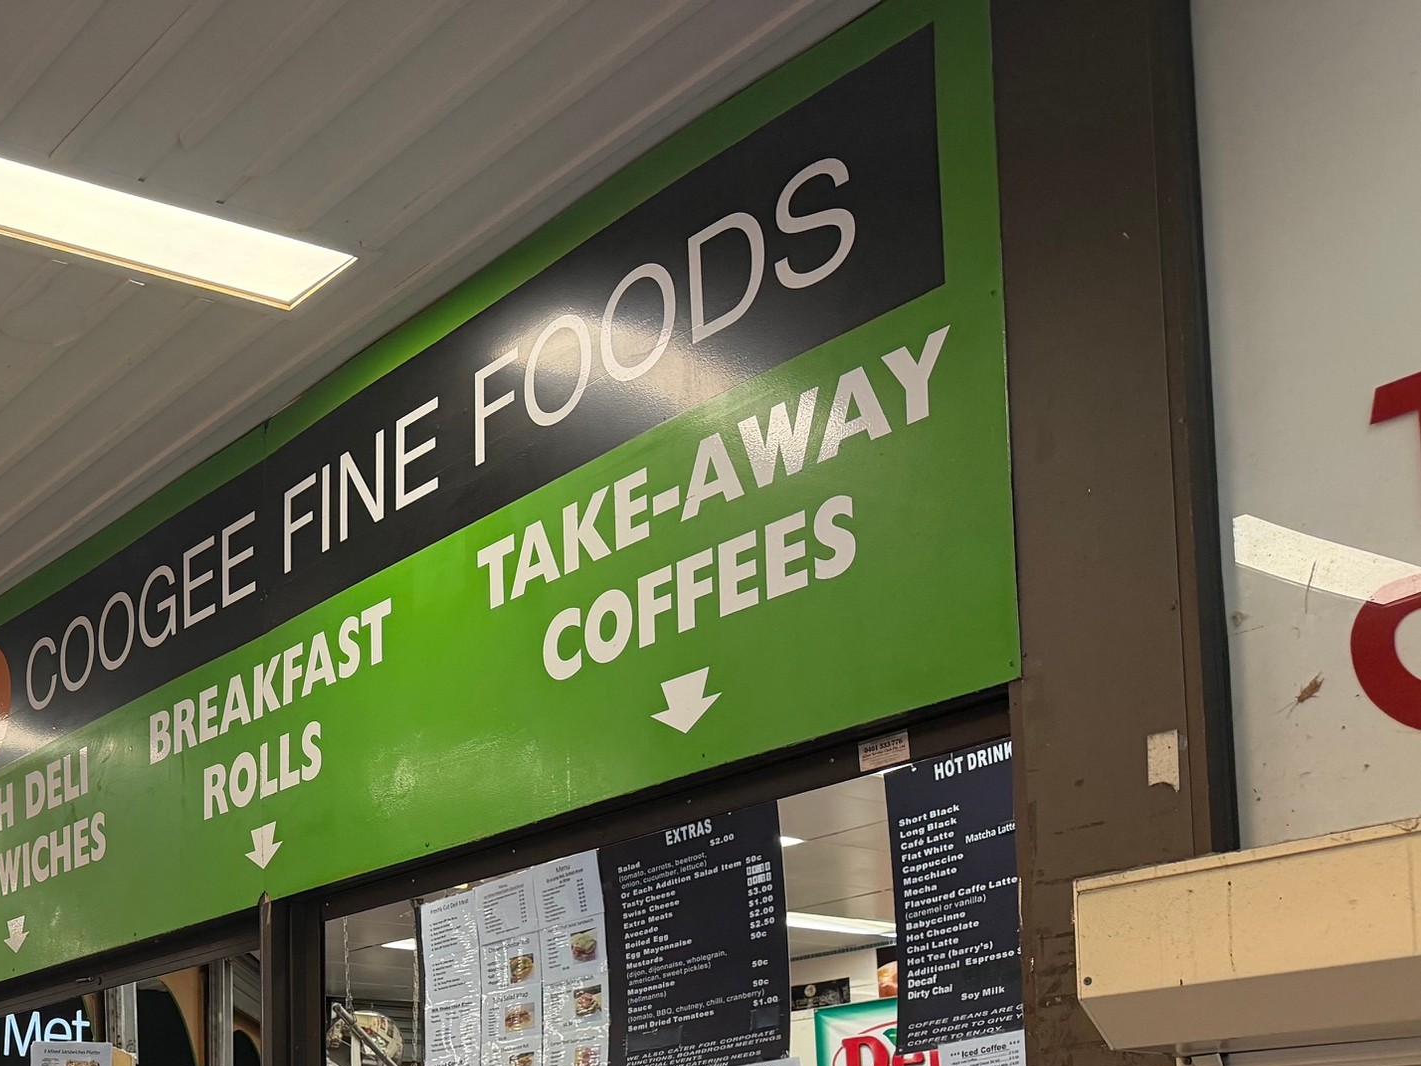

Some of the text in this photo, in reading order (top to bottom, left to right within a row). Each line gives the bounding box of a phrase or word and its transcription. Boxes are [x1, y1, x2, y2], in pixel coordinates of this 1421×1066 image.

[24, 155, 858, 712] COOGEE FINE FOODS
[475, 323, 953, 610] TAKE-AWAY
[540, 493, 859, 682] COFFEES
[147, 598, 395, 766] BREAKFAST
[202, 720, 325, 821] ROLLS
[934, 756, 963, 781] HOT
[967, 741, 1013, 771] DRINK
[23, 745, 91, 818] DELI
[898, 804, 960, 827] Short Black
[665, 818, 712, 846] EXTRAS
[900, 817, 957, 839] Long Black
[965, 822, 1015, 845] Matcha Latte
[901, 830, 955, 851] Café Latte
[901, 842, 954, 863] Flat White
[618, 833, 735, 873] Salad $2.00
[902, 852, 964, 876] Cappuccino
[633, 885, 653, 896] Each
[656, 875, 691, 890] Addition
[694, 867, 719, 879] Salad
[721, 860, 742, 872] Item
[745, 854, 762, 864] 50c
[903, 866, 957, 886] Macchiato
[622, 890, 676, 910] Tasty Cheese
[904, 884, 938, 898] Mocha
[904, 876, 1018, 910] Flavoured Caffe Latte
[623, 884, 773, 930] Extra Meats $3.00
[623, 899, 680, 920] Swiss Cheese
[624, 895, 774, 940] Avocado $1.00
[625, 906, 775, 950] Boiled Egg $2.00
[906, 911, 966, 931] Babyccinno
[906, 920, 980, 943] Hot Chocolate
[626, 917, 775, 960] Egg Mayonnaise $2.50
[750, 930, 767, 940] 50c
[907, 936, 959, 954] Chai Latte
[907, 941, 994, 967] Hot Tea (barry's)
[908, 974, 937, 988] Decaf
[908, 984, 953, 1001] Dirty Chai
[961, 985, 1005, 1001] Soy Milk
